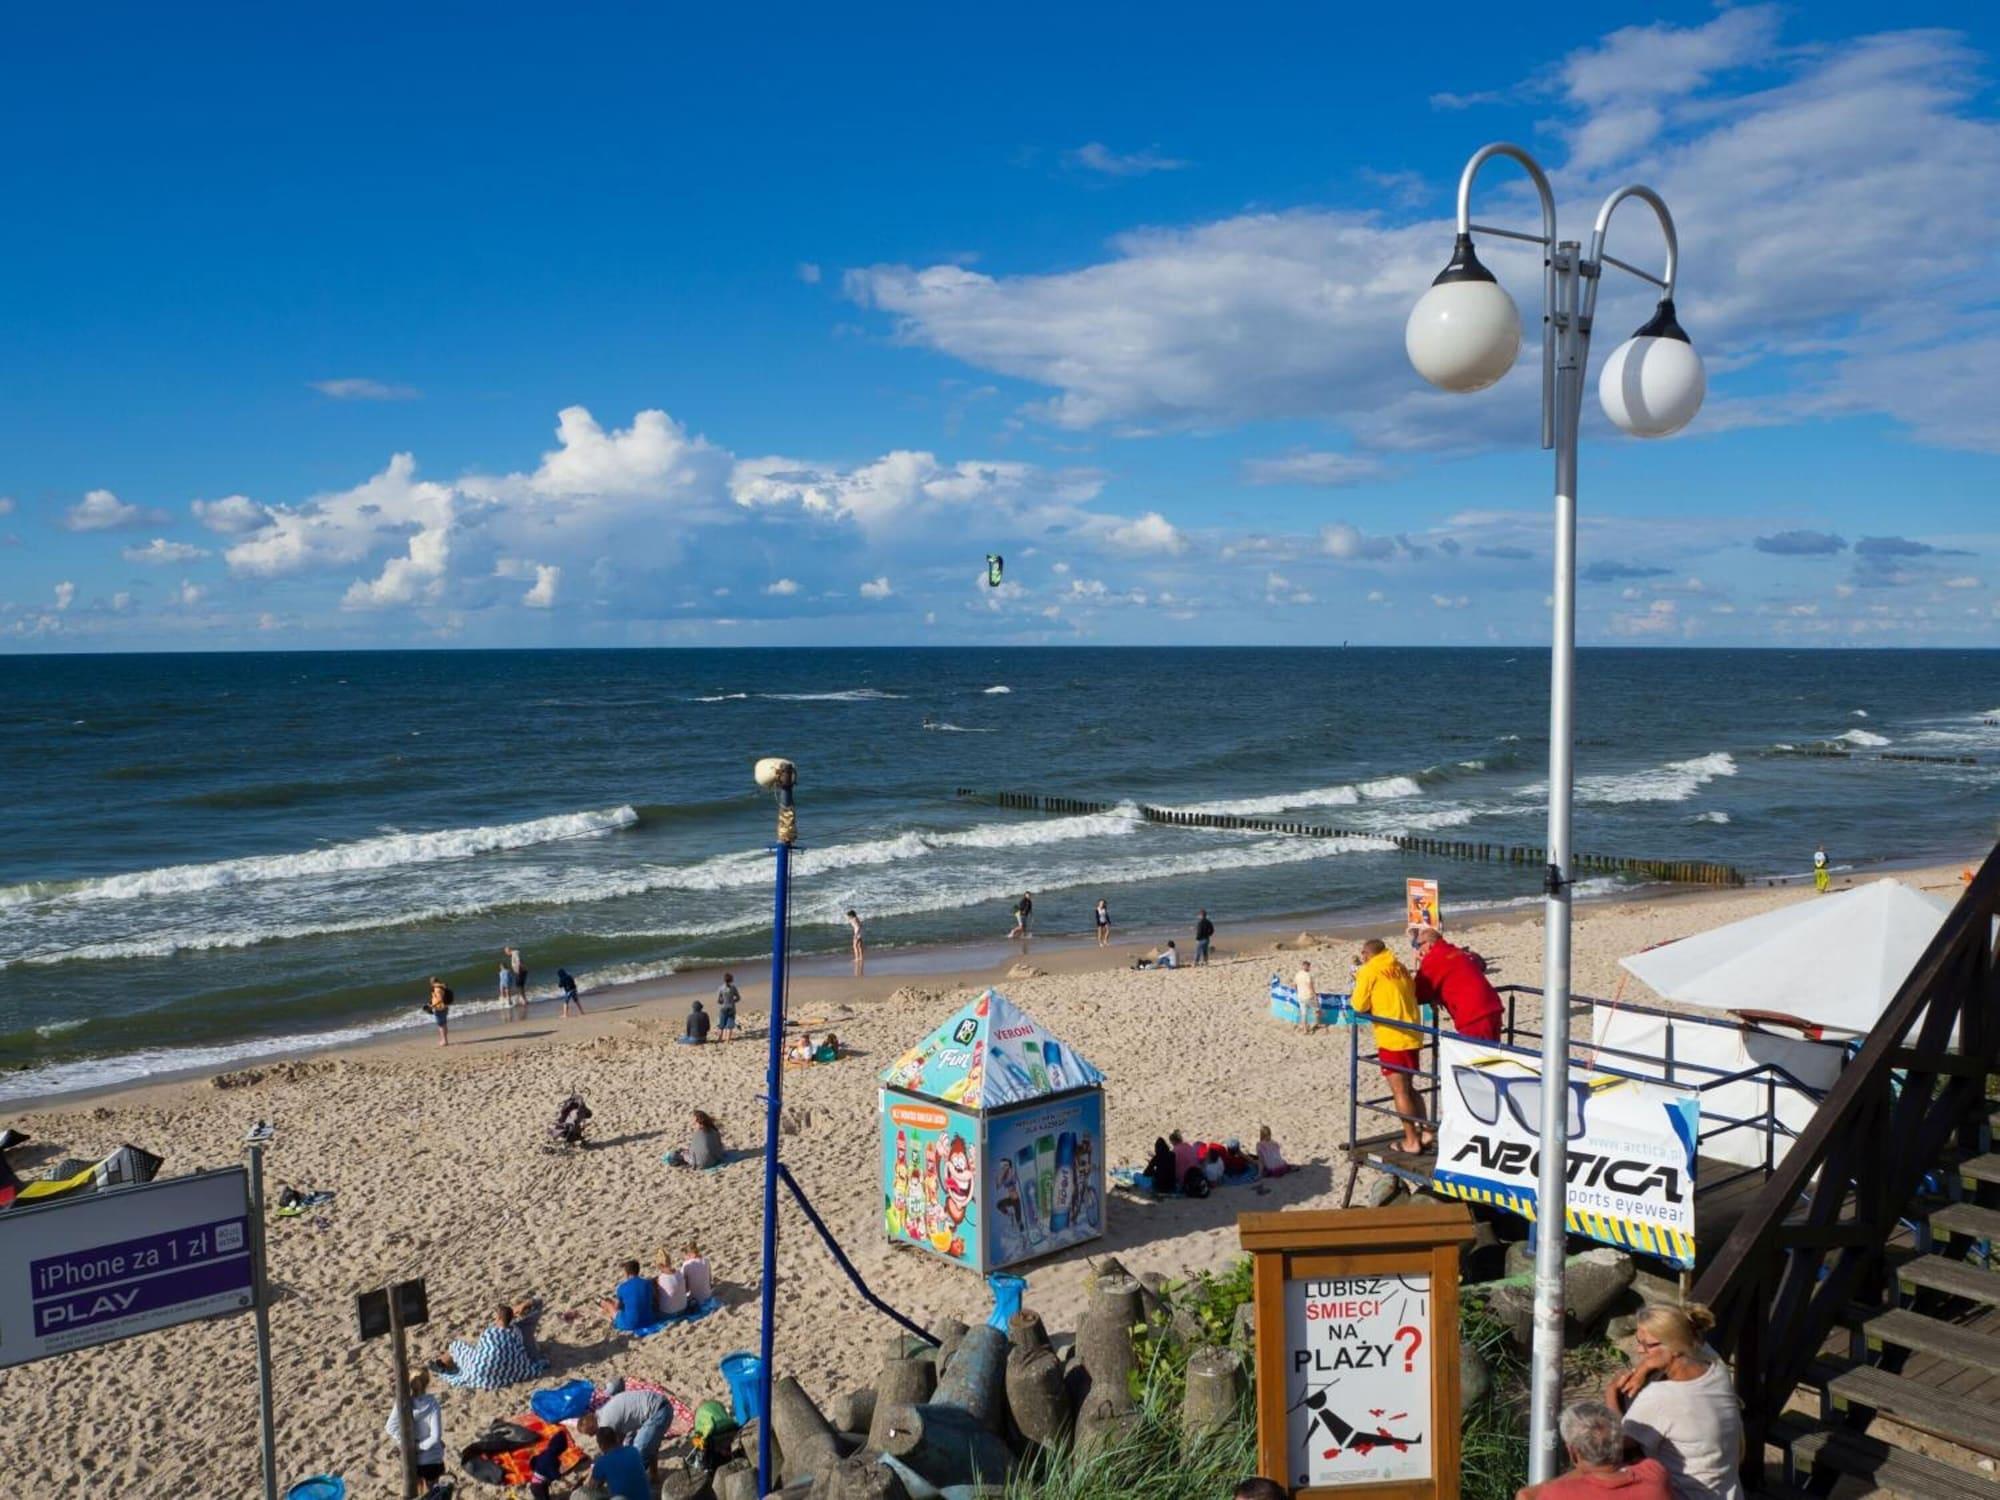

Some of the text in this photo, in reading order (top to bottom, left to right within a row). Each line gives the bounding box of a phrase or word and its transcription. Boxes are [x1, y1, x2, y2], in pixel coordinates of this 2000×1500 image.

[994, 1025, 1034, 1040] VERONI
[939, 1049, 970, 1068] Fun
[1451, 1135, 1684, 1204] ARTICA
[1566, 1188, 1685, 1223] ports eyewear
[40, 1255, 126, 1291] iPhone
[132, 1248, 160, 1271] za
[167, 1239, 178, 1261] 1
[188, 1231, 208, 1258] zł
[1305, 1279, 1381, 1298] LUBISZ
[43, 1288, 140, 1328] PLAY
[1306, 1300, 1380, 1320] ŚMIECI
[1329, 1324, 1358, 1340] NA
